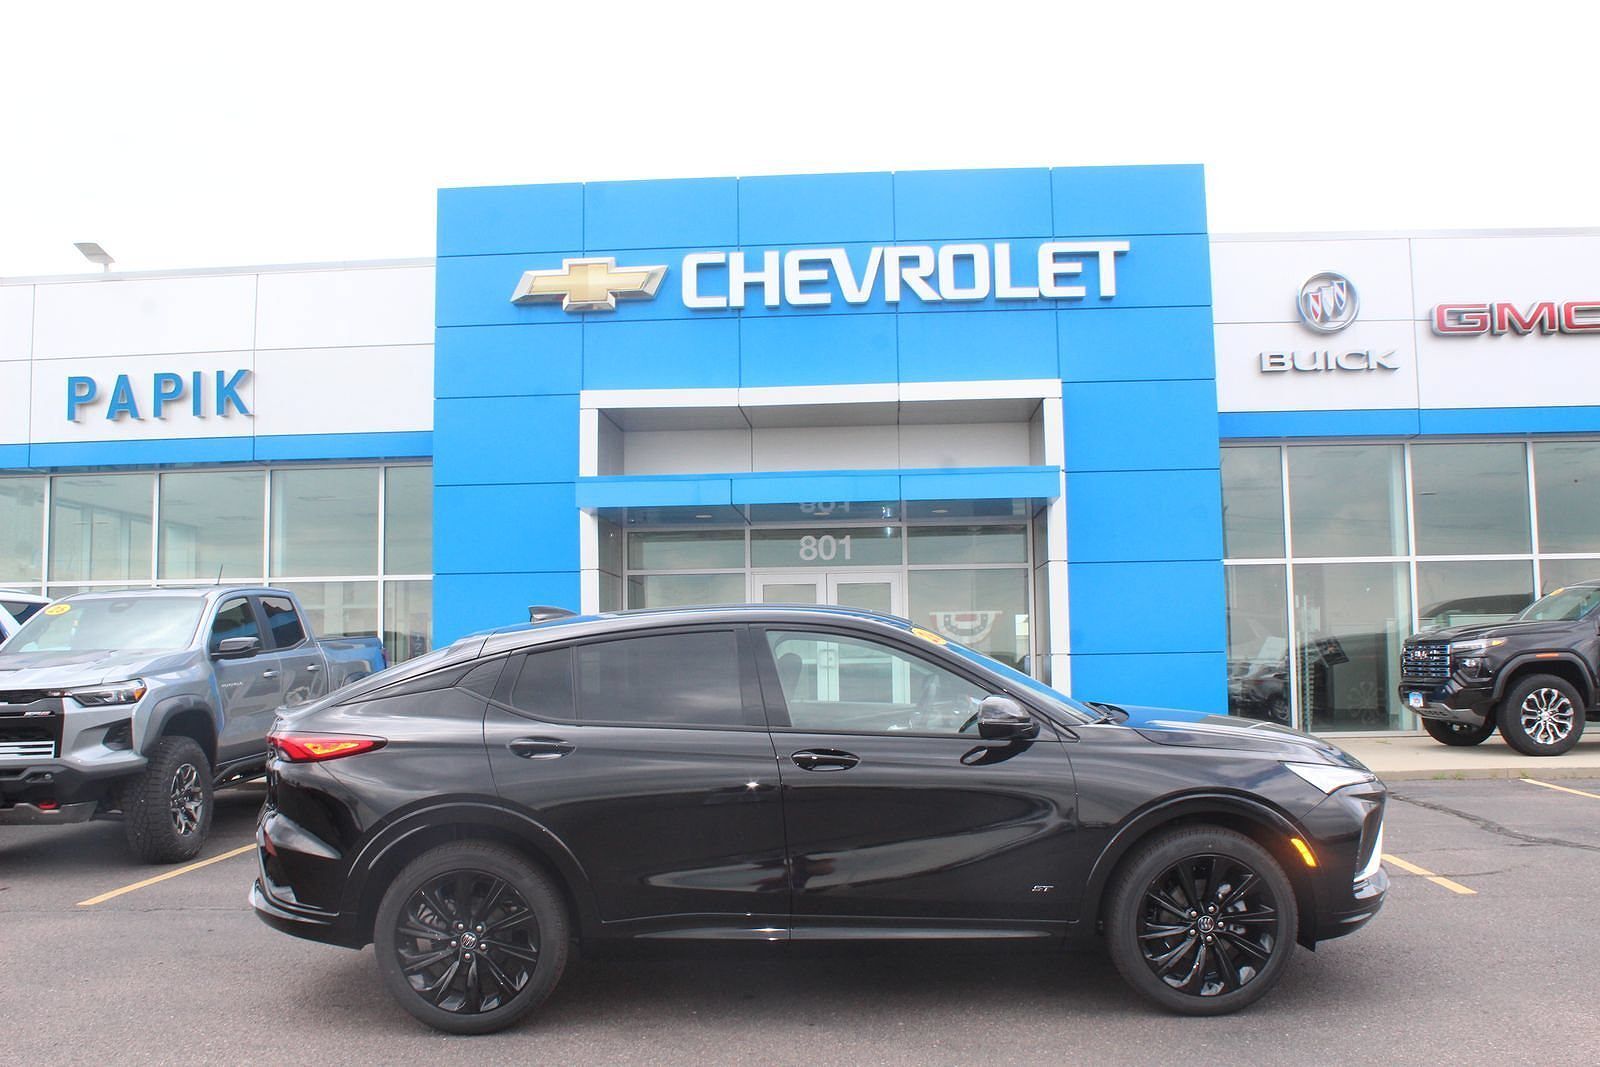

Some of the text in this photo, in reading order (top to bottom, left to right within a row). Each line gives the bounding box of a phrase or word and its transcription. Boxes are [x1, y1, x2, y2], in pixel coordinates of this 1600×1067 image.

[681, 240, 1131, 309] CHEVROLET
[1431, 302, 1600, 338] GMC
[1259, 350, 1400, 374] BUICK
[67, 369, 254, 424] PAPIK
[799, 534, 852, 561] 801
